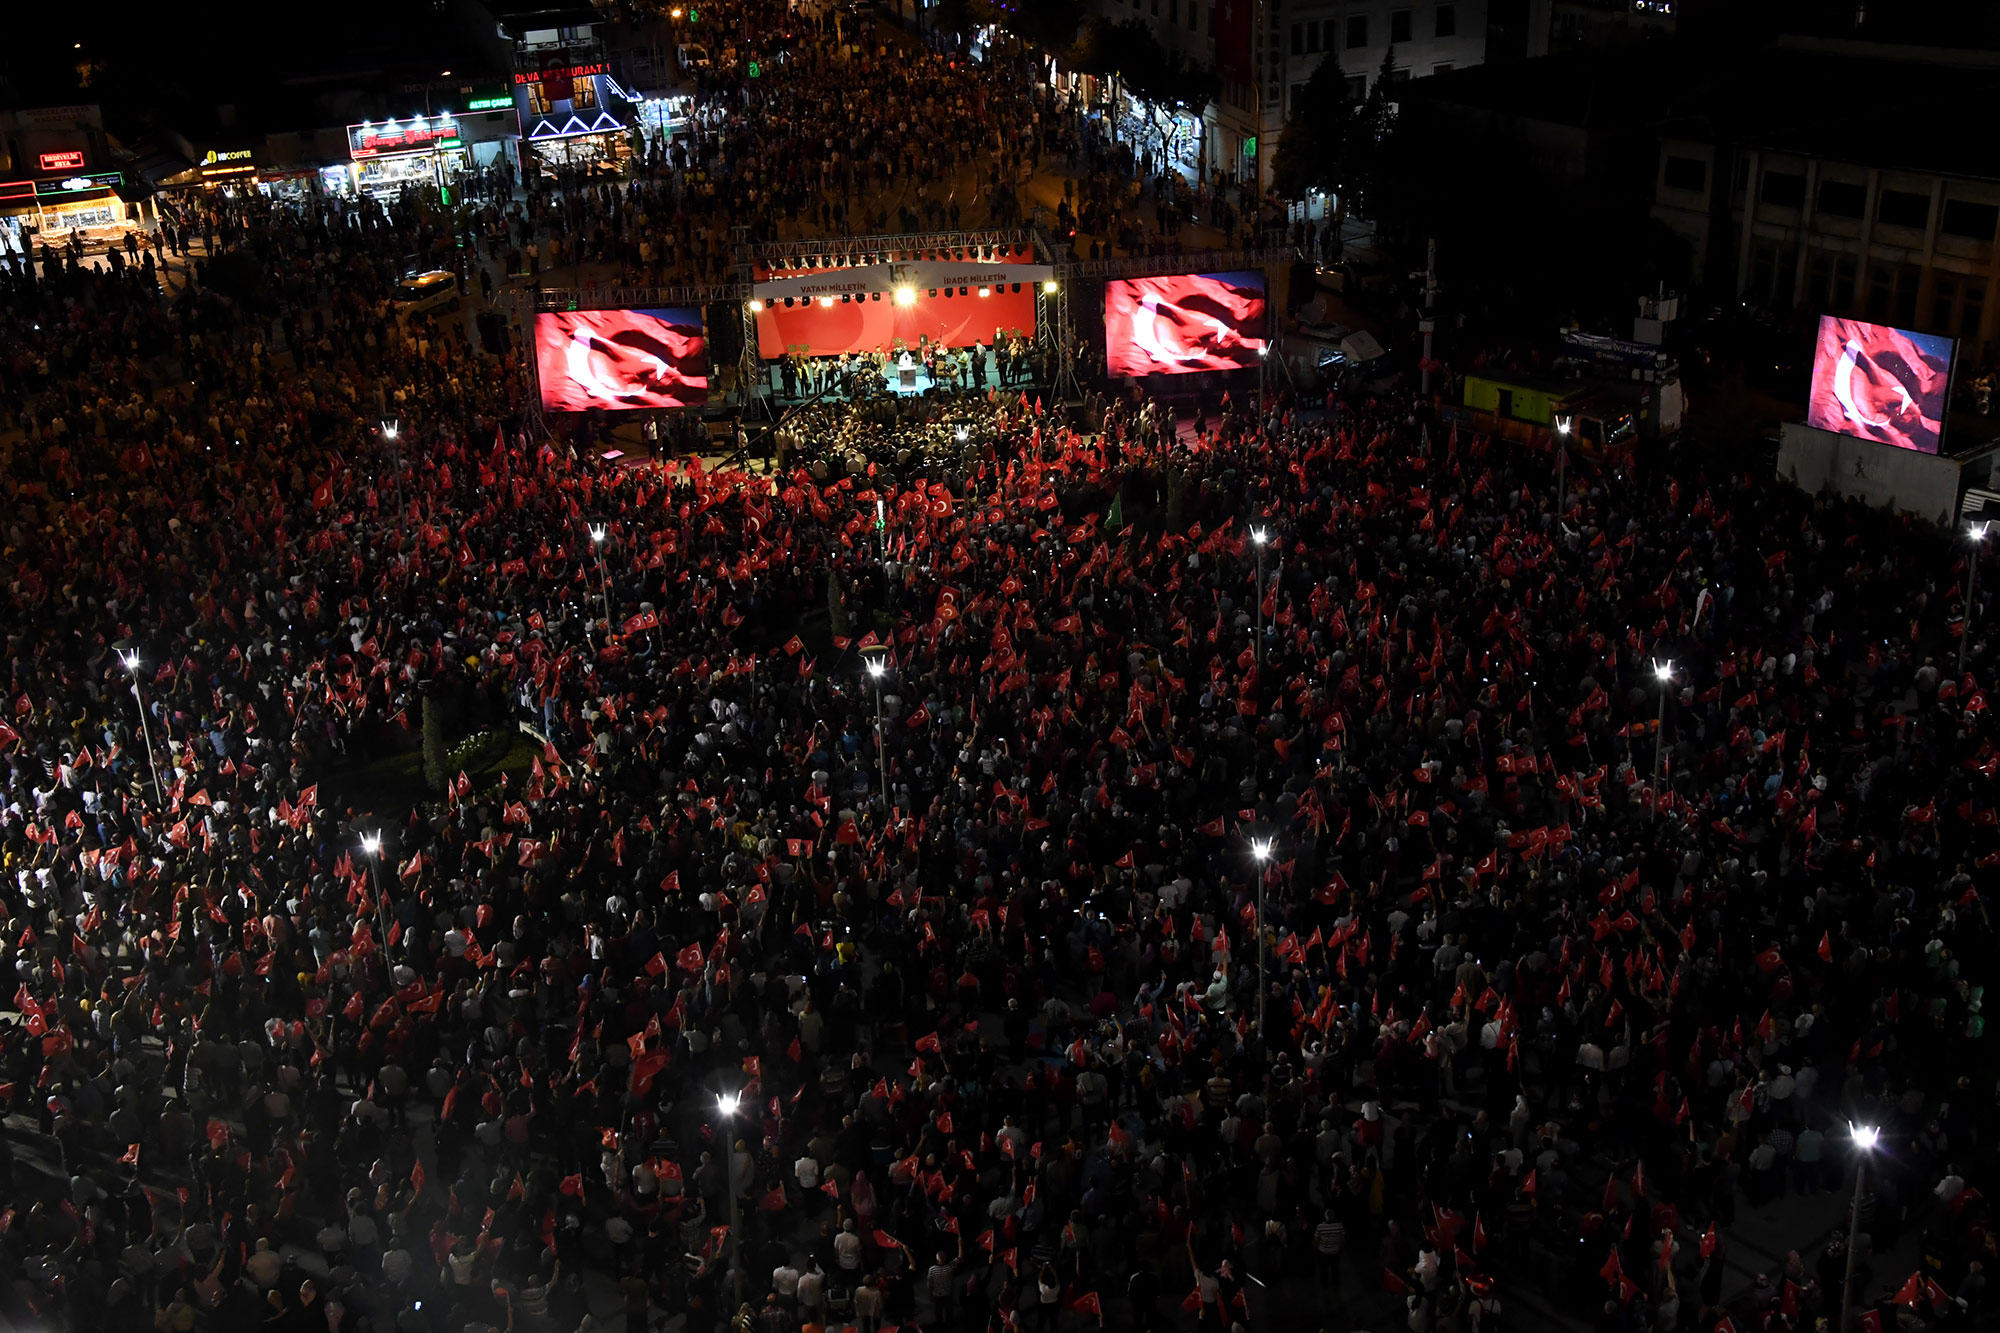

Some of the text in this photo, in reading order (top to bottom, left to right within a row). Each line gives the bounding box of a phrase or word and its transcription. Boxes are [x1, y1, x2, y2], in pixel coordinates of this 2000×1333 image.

[514, 71, 540, 84] DEVA
[943, 273, 1007, 285] İRADE MİLLETİN
[800, 282, 866, 293] VATAN MİLLETİN
